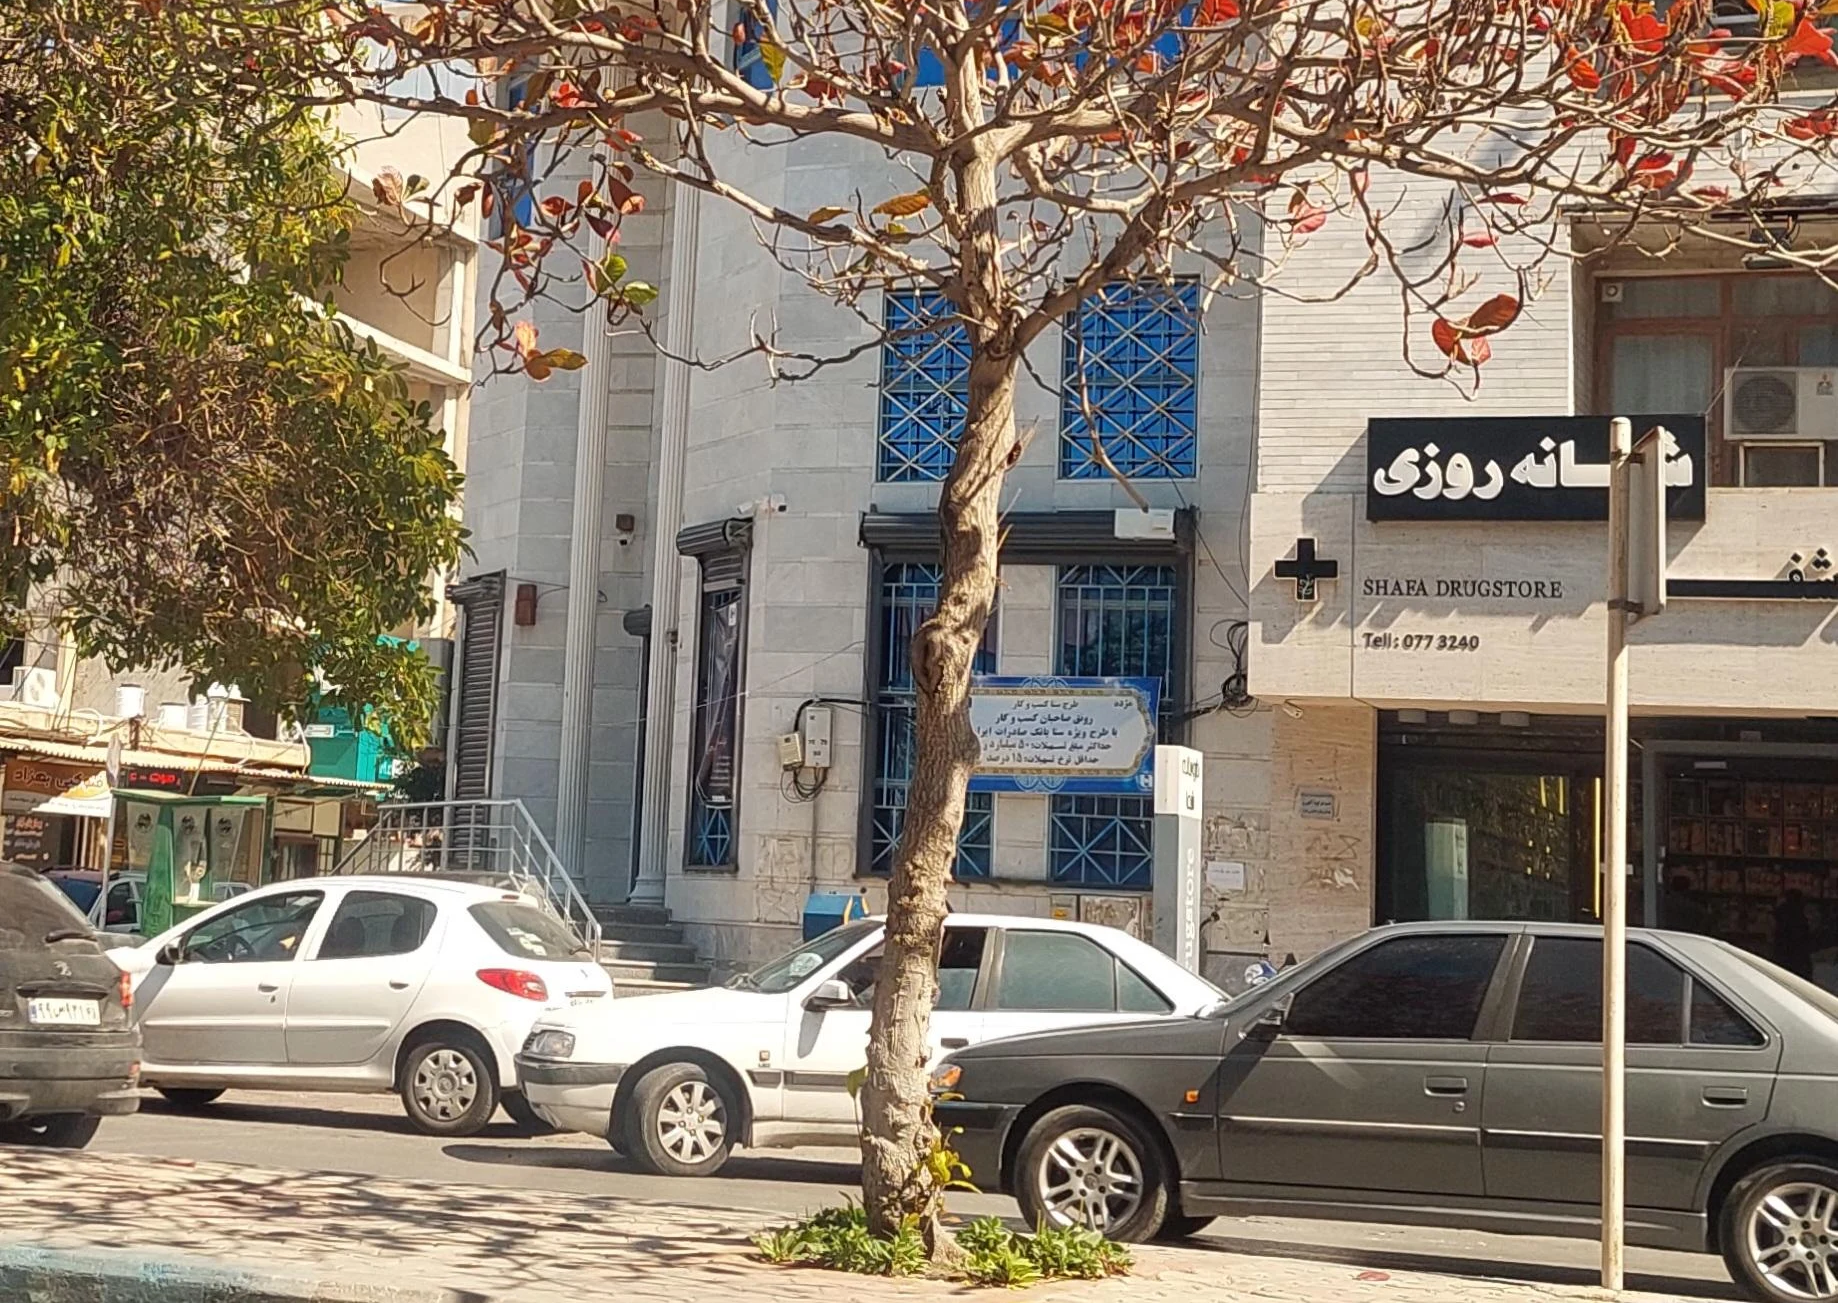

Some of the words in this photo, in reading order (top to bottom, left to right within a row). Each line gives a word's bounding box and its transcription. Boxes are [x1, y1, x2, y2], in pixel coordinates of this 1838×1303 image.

[1510, 429, 1694, 487] شانه
[1373, 441, 1504, 500] روزی
[1362, 577, 1428, 598] SHAFA
[1435, 579, 1564, 600] DRUGSTORE
[1062, 700, 1079, 710] طرح
[995, 713, 1009, 725] کار
[1017, 713, 1039, 723] کسب
[1040, 713, 1072, 725] صاحبان
[995, 727, 1027, 738] صادرات
[1029, 727, 1050, 738] بانک
[1089, 727, 1110, 738] طرح
[1184, 847, 1197, 973] rugstore
